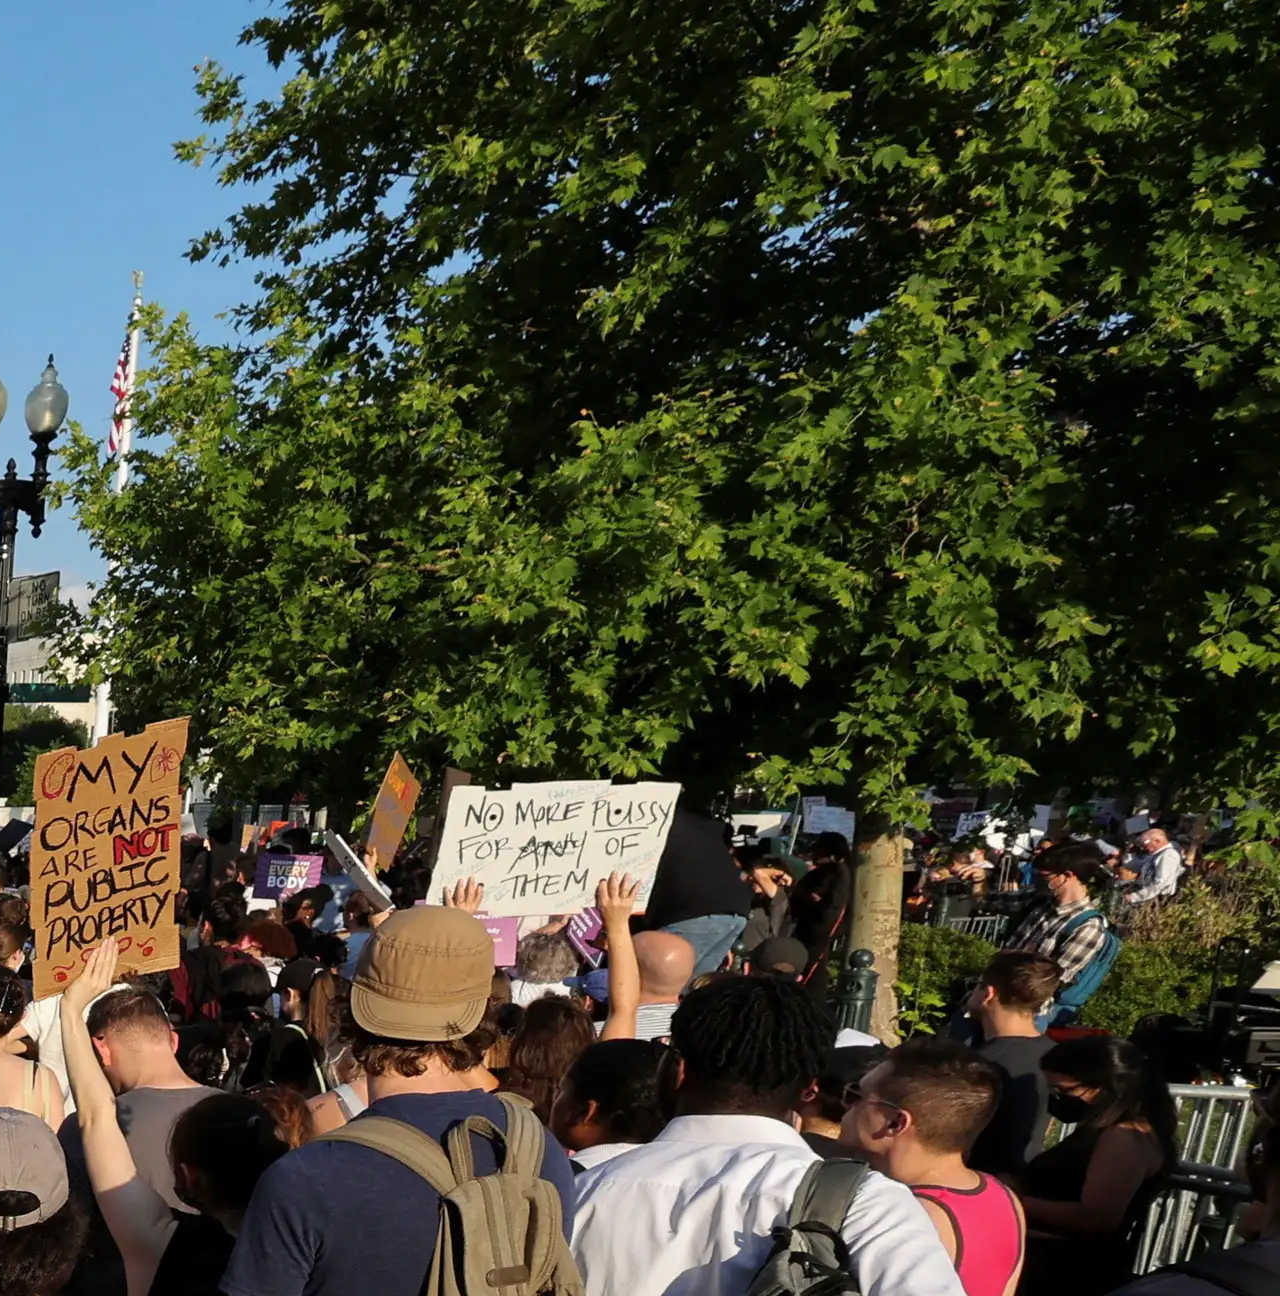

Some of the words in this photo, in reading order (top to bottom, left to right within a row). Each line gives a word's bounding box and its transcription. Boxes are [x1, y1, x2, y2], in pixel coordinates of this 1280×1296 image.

[27, 592, 51, 607] TURN
[31, 579, 47, 592] NO
[21, 611, 33, 622] ON
[67, 740, 159, 803] MY
[40, 795, 170, 851] ORGANS
[464, 795, 504, 833] NO
[515, 798, 585, 829] MORE
[592, 799, 673, 838] PUSSY
[39, 847, 97, 880] ARE
[113, 823, 178, 866] NOT
[457, 832, 514, 865] FOR
[605, 831, 642, 858] OF
[267, 875, 308, 889] BODY
[269, 865, 310, 877] EVERY
[501, 868, 589, 900] THEM
[44, 856, 170, 921] PUBLIC
[46, 889, 172, 961] PROPERTY
